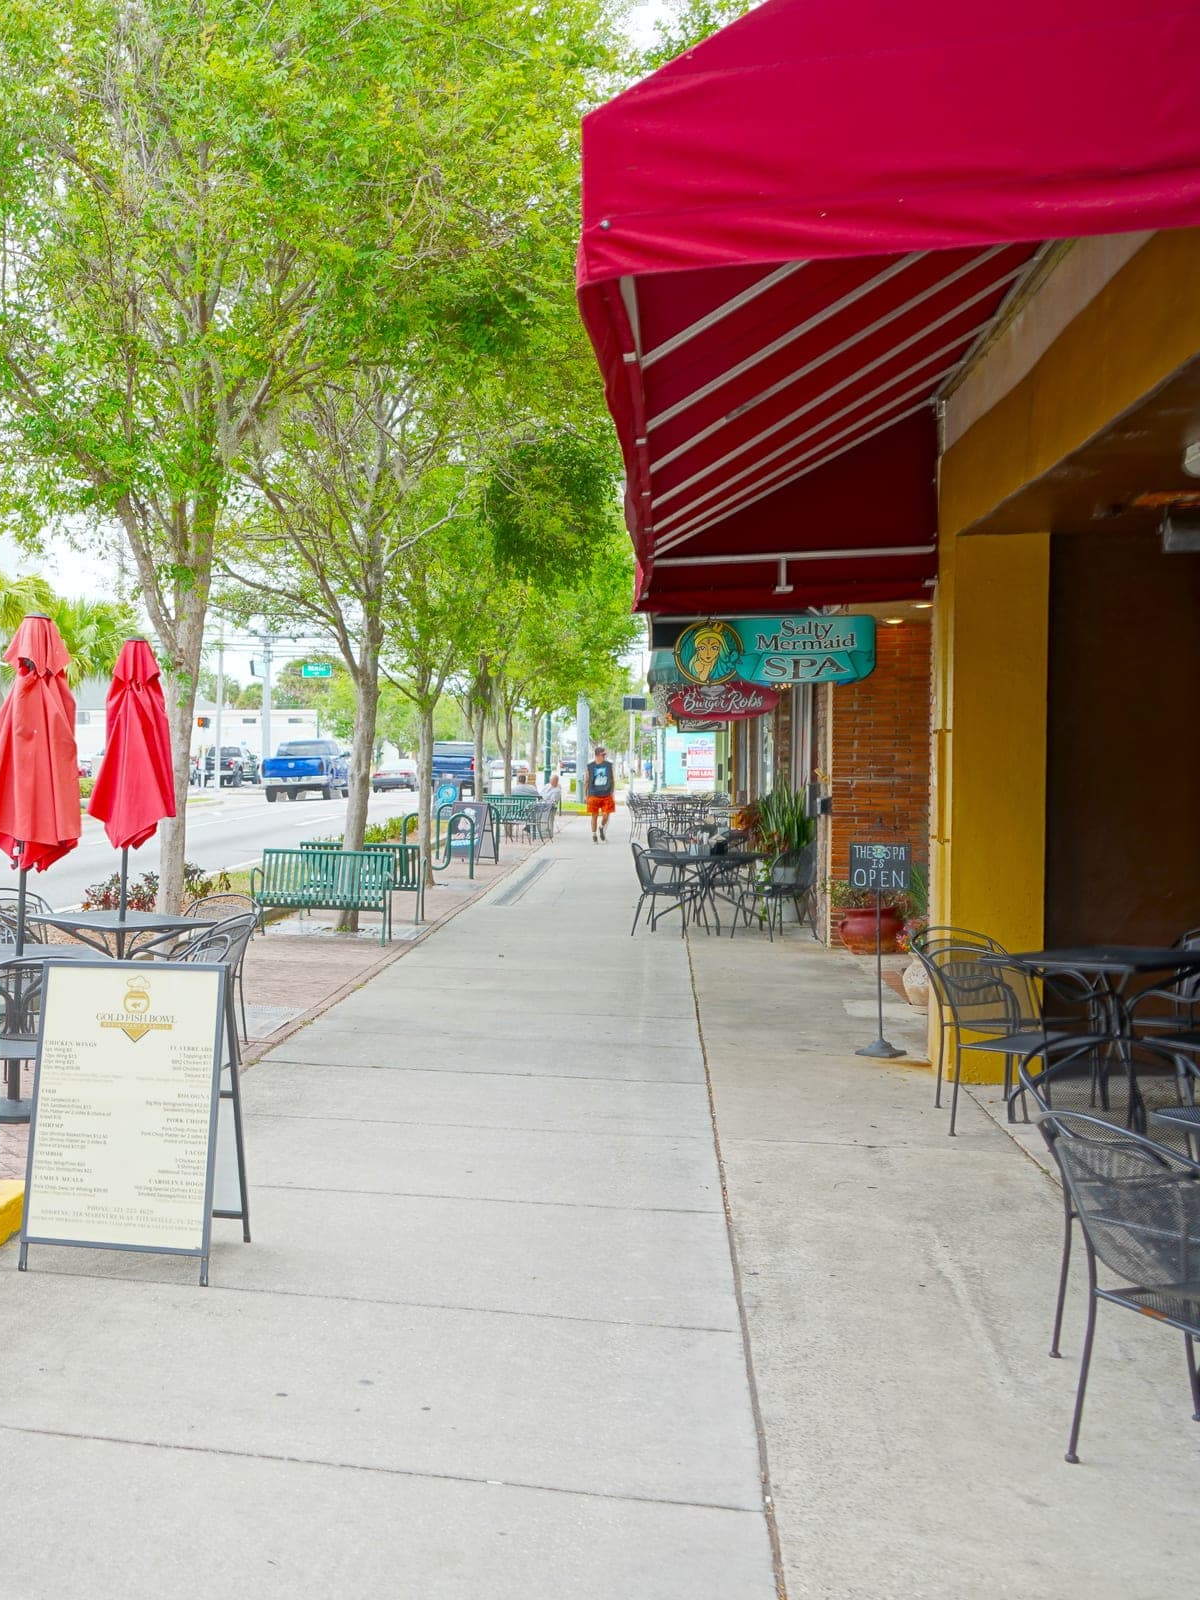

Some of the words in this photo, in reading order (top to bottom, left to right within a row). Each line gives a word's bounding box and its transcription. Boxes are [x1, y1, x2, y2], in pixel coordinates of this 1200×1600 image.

[781, 619, 834, 642] Salty
[757, 633, 856, 651] Mermaid
[764, 656, 849, 681] SPA
[683, 692, 727, 715] Burger
[726, 690, 763, 712] Robs
[853, 845, 874, 859] THE
[884, 846, 907, 861] SPA
[871, 859, 886, 868] IS
[854, 868, 904, 888] OPEN
[95, 1012, 124, 1022] GOLD
[125, 1013, 148, 1023] FISH
[148, 1014, 177, 1024] BOWL
